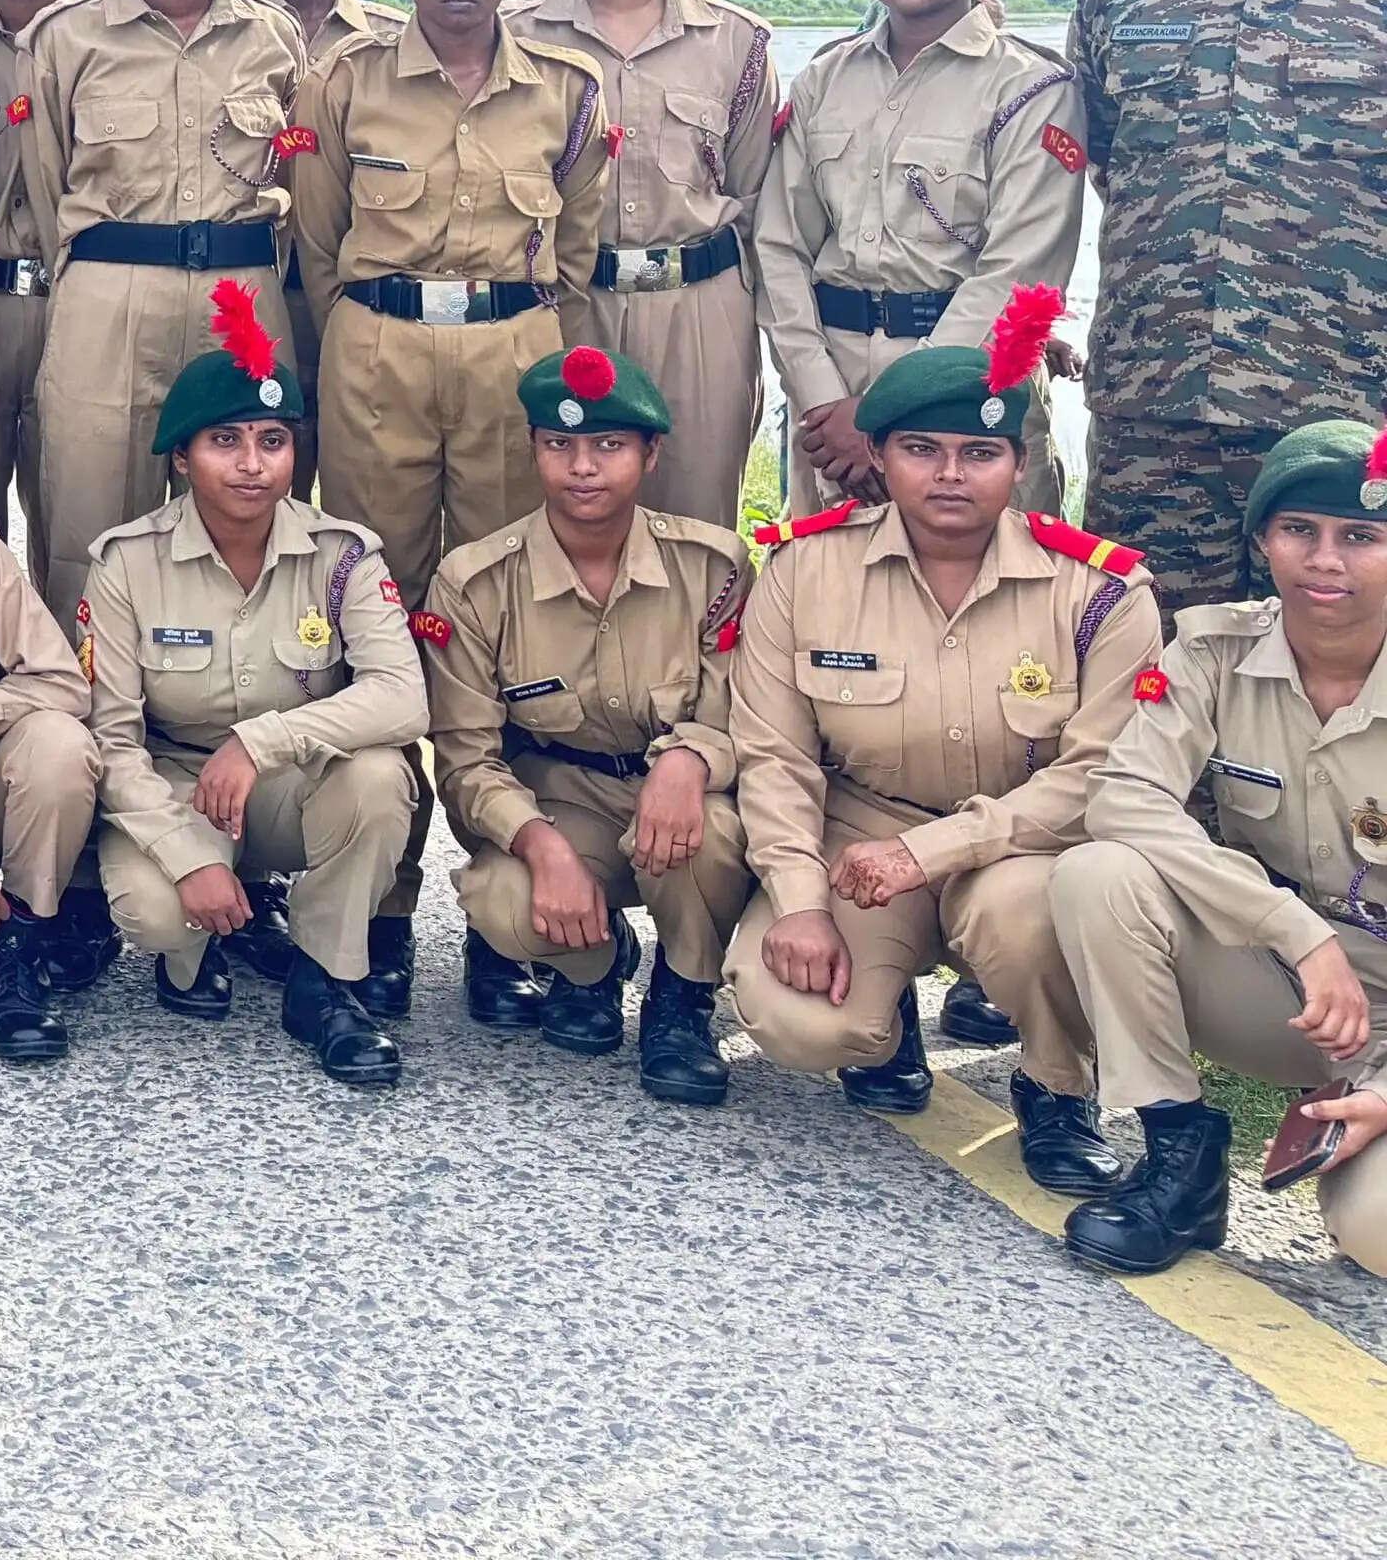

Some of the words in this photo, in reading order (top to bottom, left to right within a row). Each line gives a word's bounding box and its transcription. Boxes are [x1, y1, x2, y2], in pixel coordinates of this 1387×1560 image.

[279, 130, 312, 150] NCC
[1050, 129, 1078, 162] NCC
[414, 617, 445, 638] NCC
